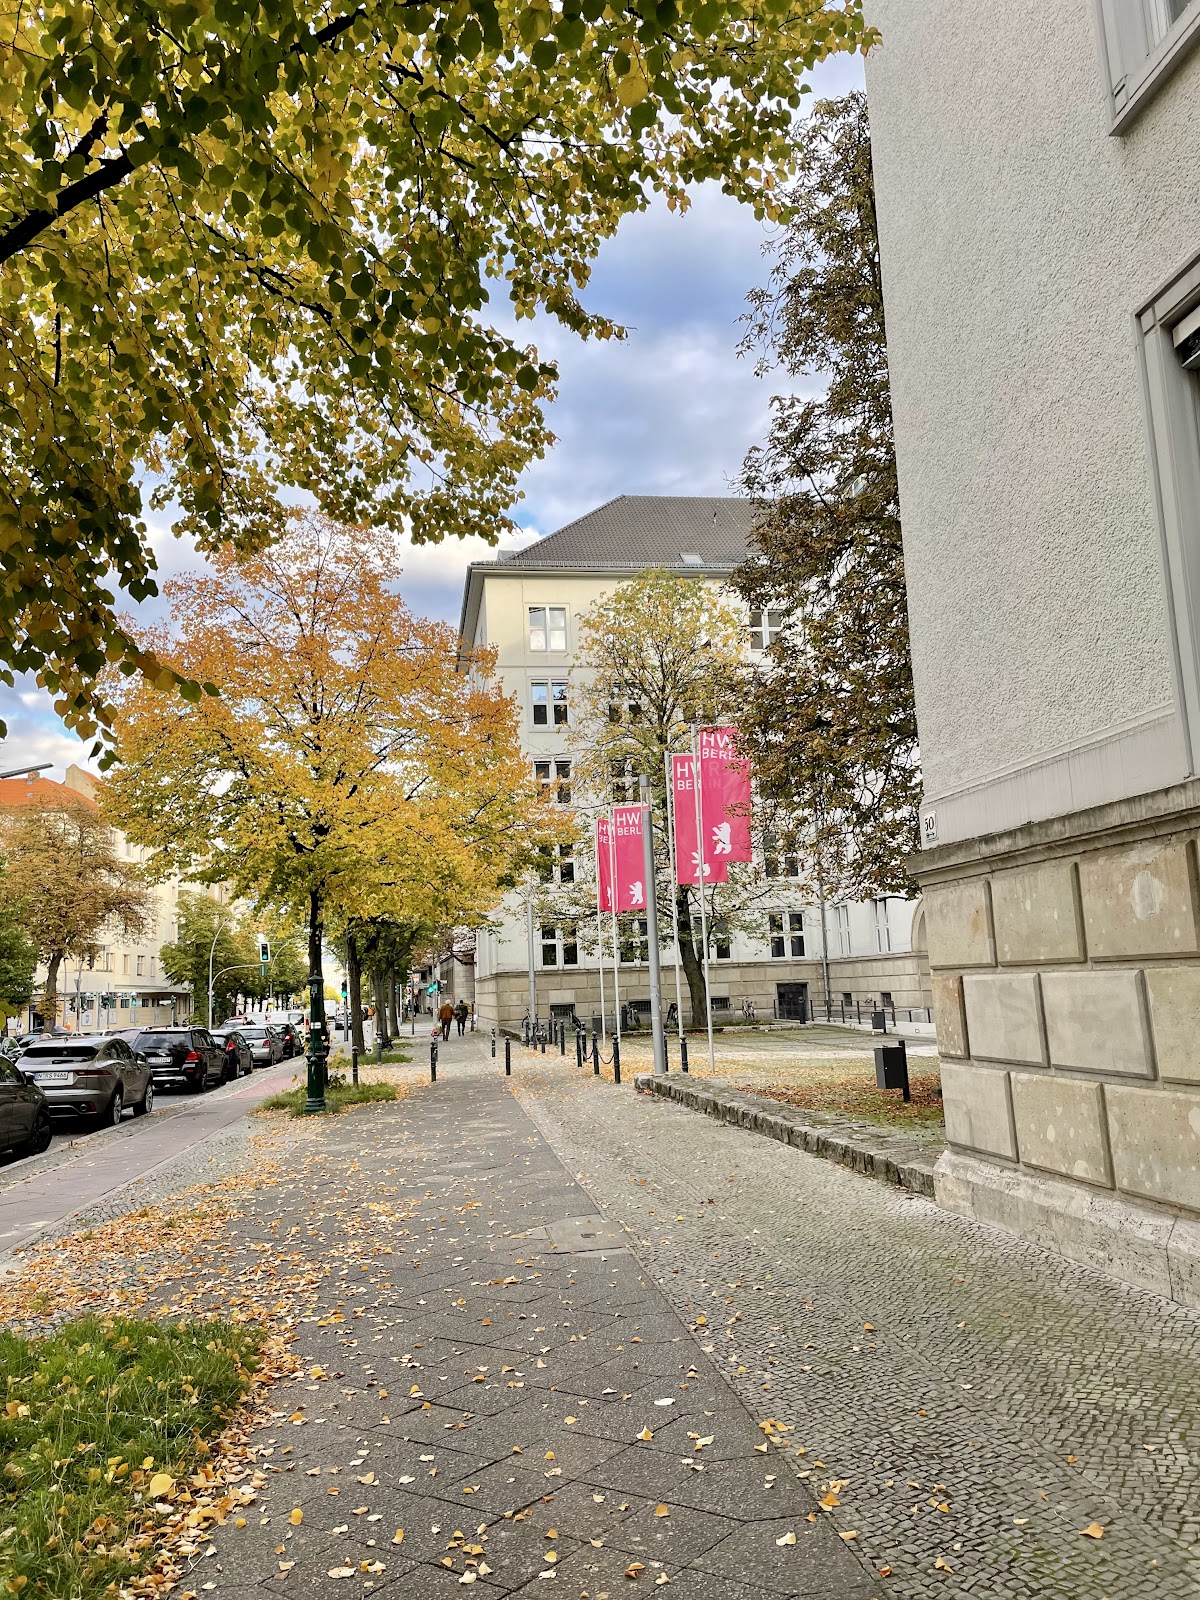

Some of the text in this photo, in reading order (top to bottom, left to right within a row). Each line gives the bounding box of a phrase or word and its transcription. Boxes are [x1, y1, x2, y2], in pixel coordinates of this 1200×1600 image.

[702, 731, 733, 749] HW
[616, 811, 641, 827] HW
[617, 826, 642, 837] BERL
